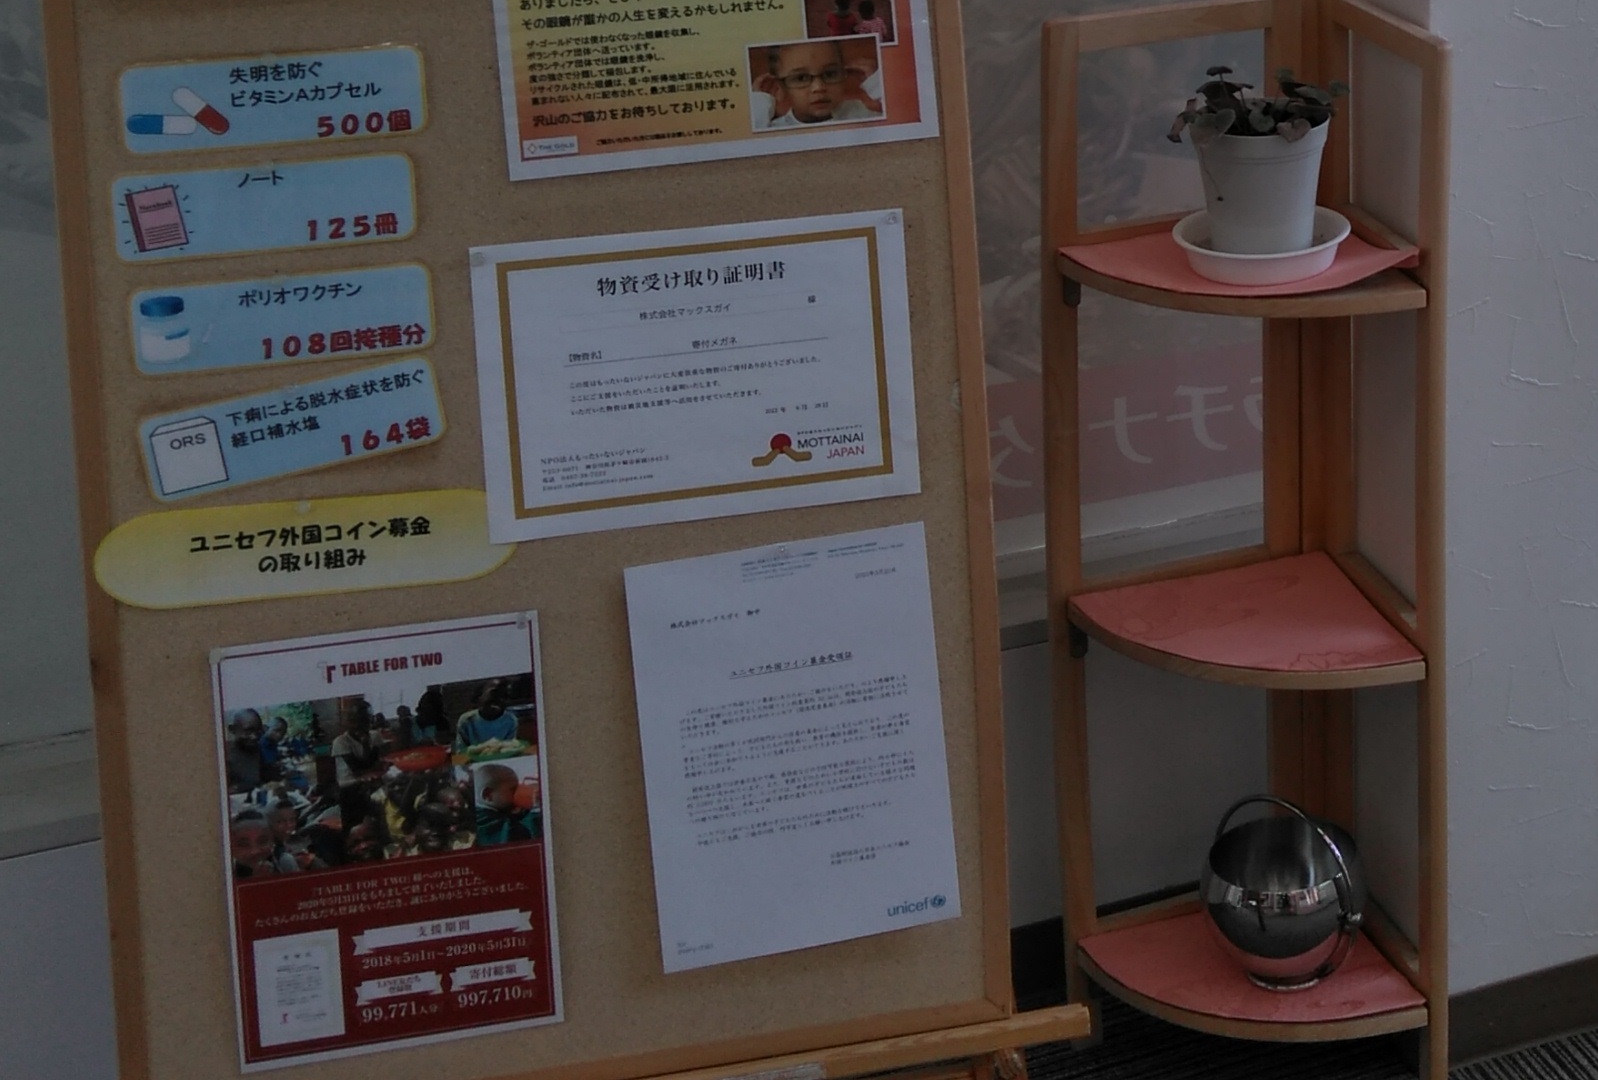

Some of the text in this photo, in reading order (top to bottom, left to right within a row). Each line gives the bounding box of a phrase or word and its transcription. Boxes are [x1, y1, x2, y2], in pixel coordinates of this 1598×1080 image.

[229, 61, 323, 85] 失明を防ぐ
[230, 82, 381, 108] ビタミンAカプセル
[316, 108, 412, 138] 500個
[237, 170, 284, 189] ノート
[307, 212, 399, 242] 125冊
[596, 260, 787, 297] 物資受け取り証明書
[237, 280, 363, 309] ポリオワクチン
[261, 322, 426, 360] 108回接種分
[169, 432, 206, 451] ORS
[230, 415, 321, 449] 経口補水塩
[340, 415, 432, 457] 164袋
[797, 432, 864, 449] MOTTAINAI
[826, 445, 865, 459] JAPAN
[189, 515, 432, 553] ユニセフ外国コイン募金
[257, 548, 367, 574] の取り組み
[341, 651, 443, 678] TABLE FOR TWO
[887, 896, 931, 917] unicef
